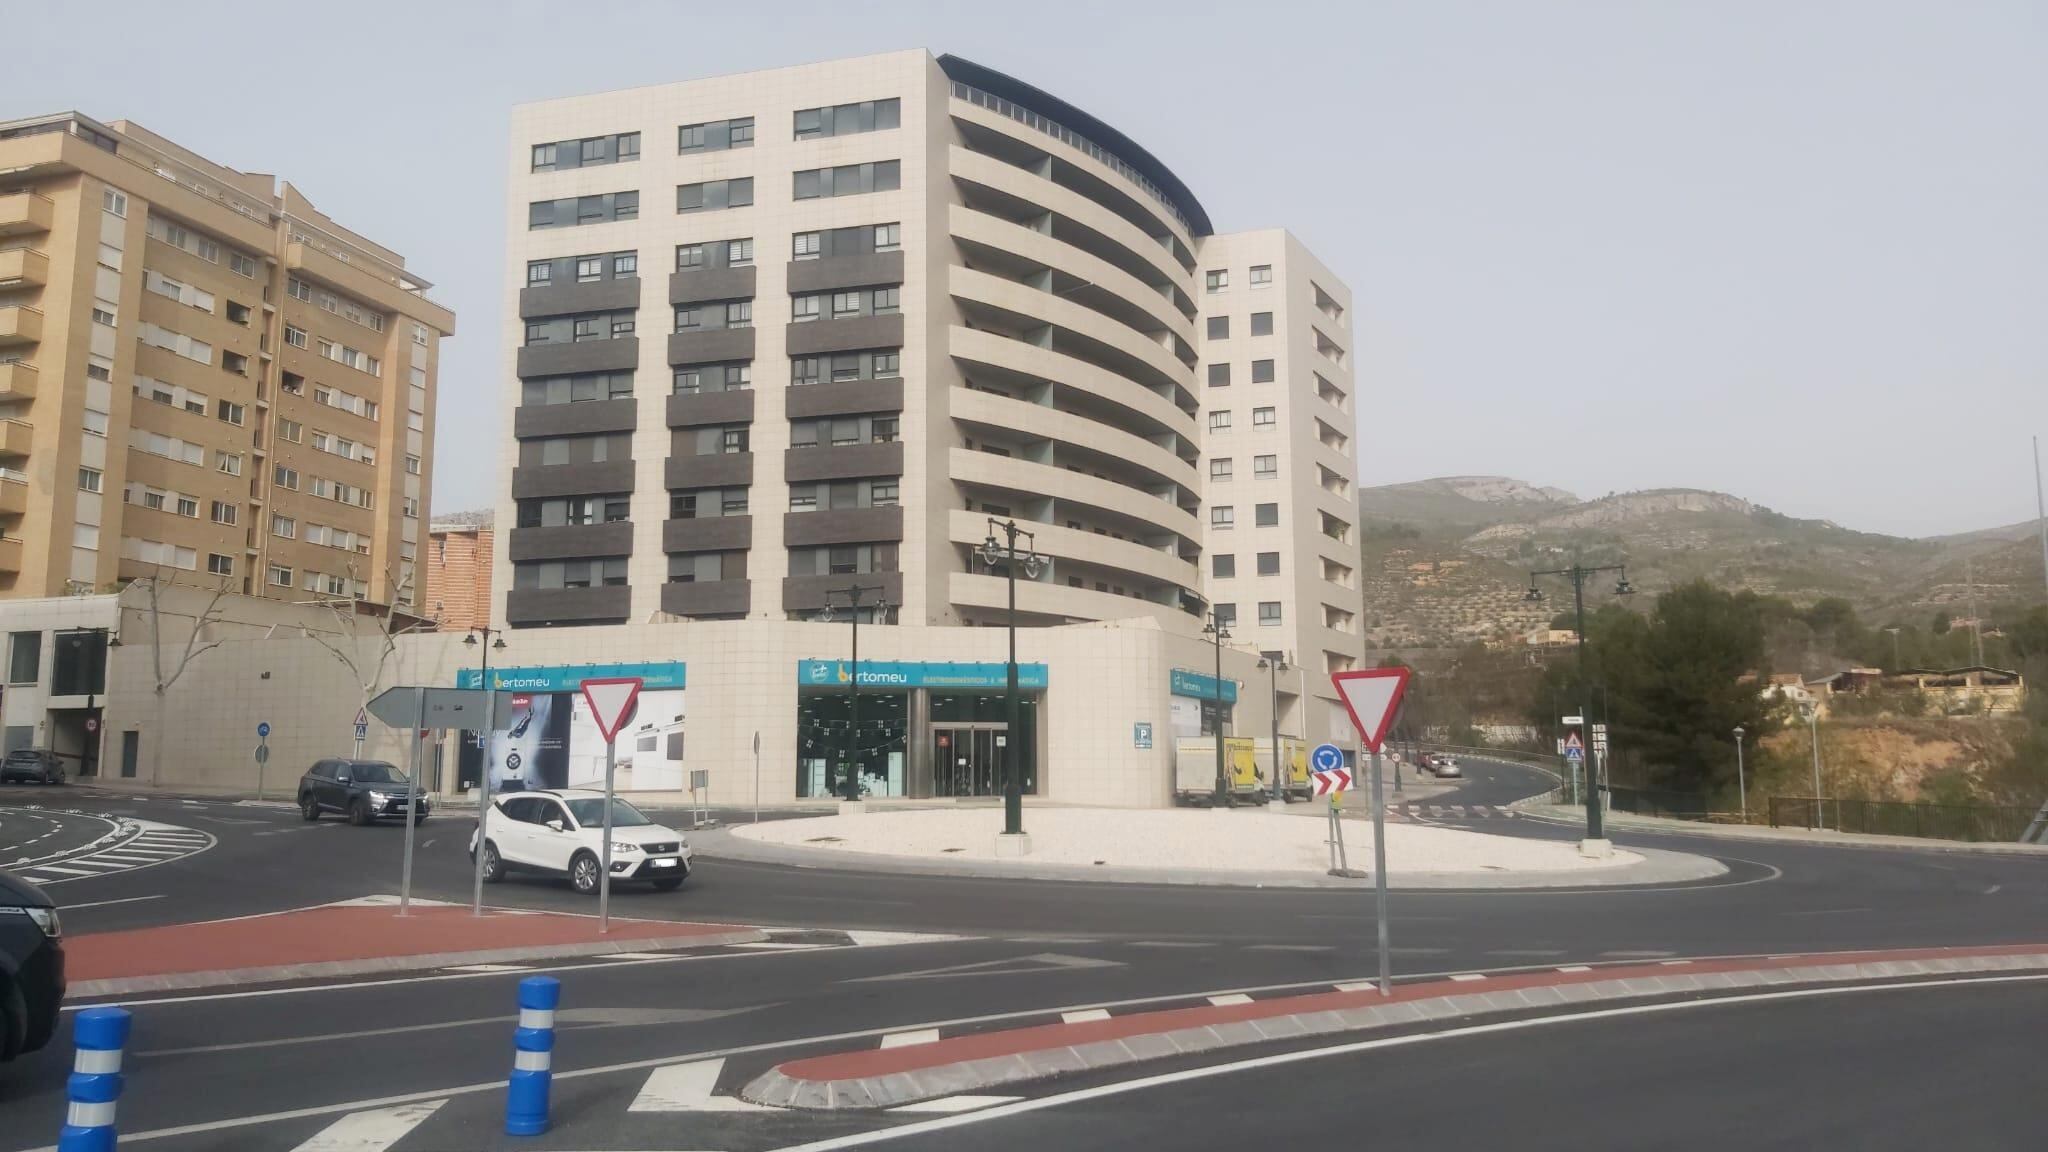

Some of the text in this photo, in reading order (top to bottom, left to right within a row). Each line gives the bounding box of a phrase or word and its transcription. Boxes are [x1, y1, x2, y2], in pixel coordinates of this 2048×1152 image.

[495, 672, 550, 688] bertomeu
[838, 664, 906, 682] bertomeu
[1141, 729, 1147, 739] P
